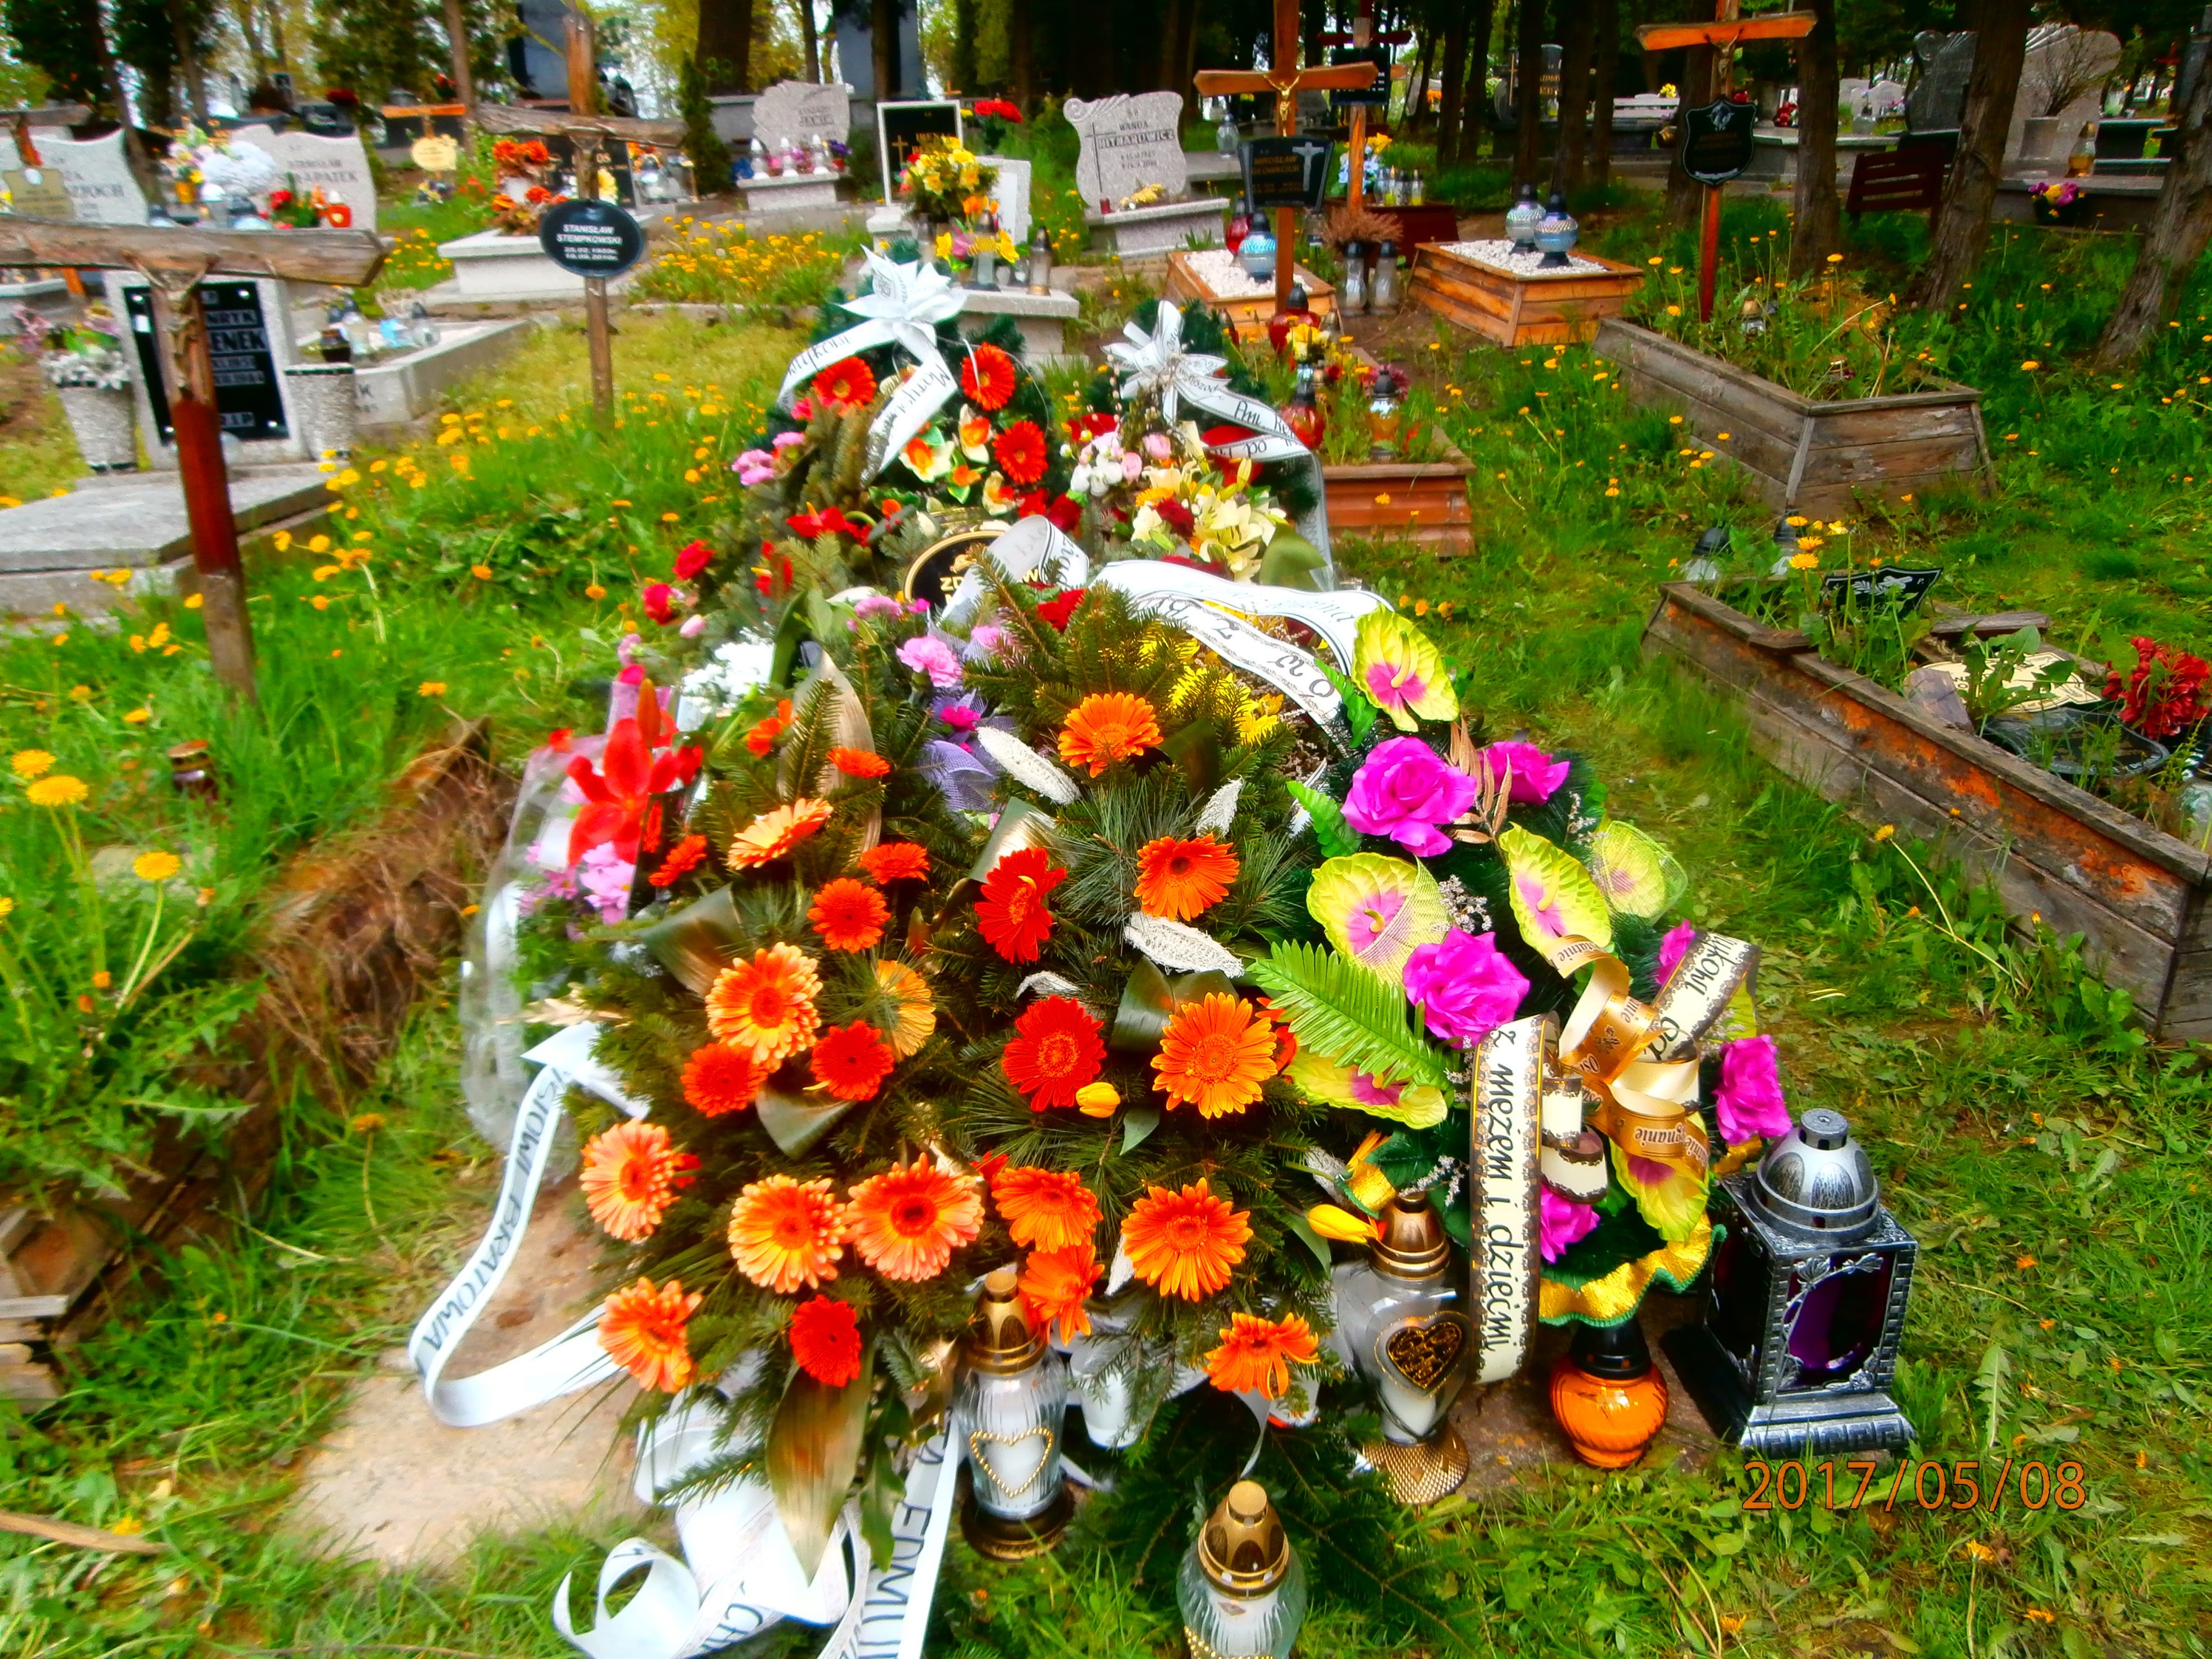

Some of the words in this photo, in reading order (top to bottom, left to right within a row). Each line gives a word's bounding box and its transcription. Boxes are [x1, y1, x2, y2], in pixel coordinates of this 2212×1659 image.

[1118, 120, 1148, 131] WANDA
[562, 224, 615, 236] STANISŁAW
[555, 233, 623, 246] STEMPKOWSKI
